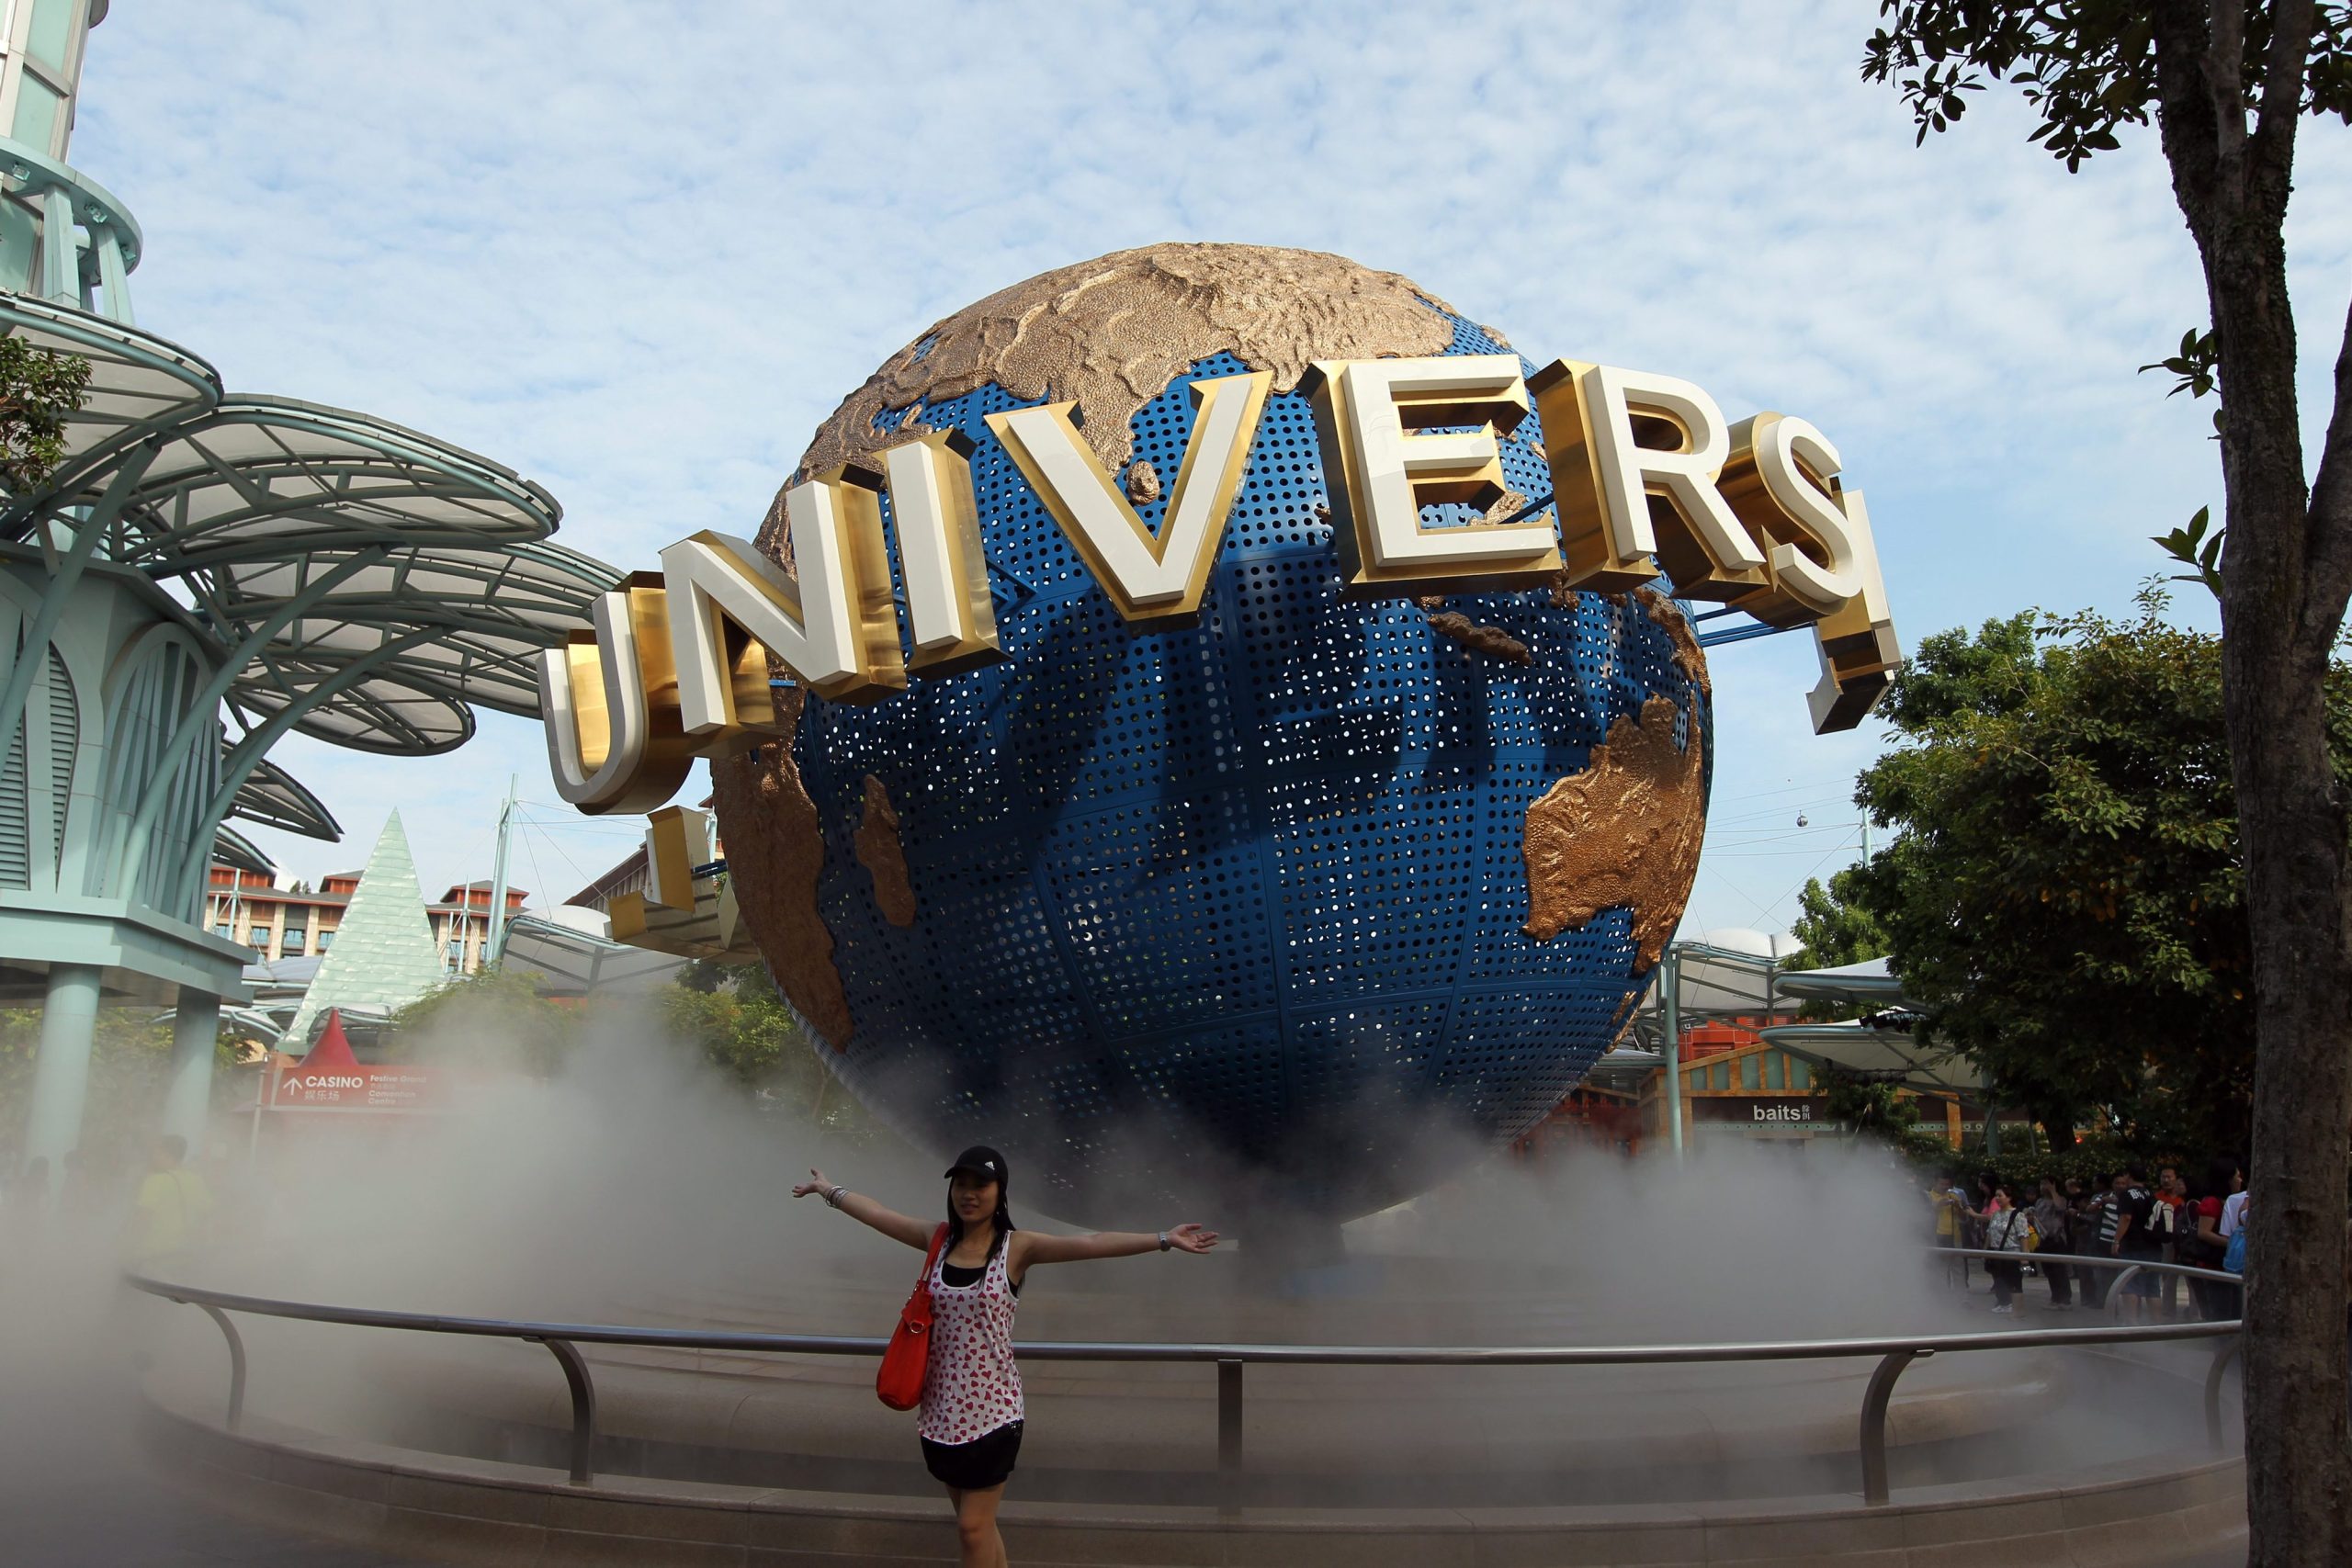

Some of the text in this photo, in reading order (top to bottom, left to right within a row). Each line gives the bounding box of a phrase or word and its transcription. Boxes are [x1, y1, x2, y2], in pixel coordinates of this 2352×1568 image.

[544, 355, 1904, 818] UNIVERS
[305, 1076, 364, 1089] CASINO
[1753, 1104, 1801, 1121] baits
